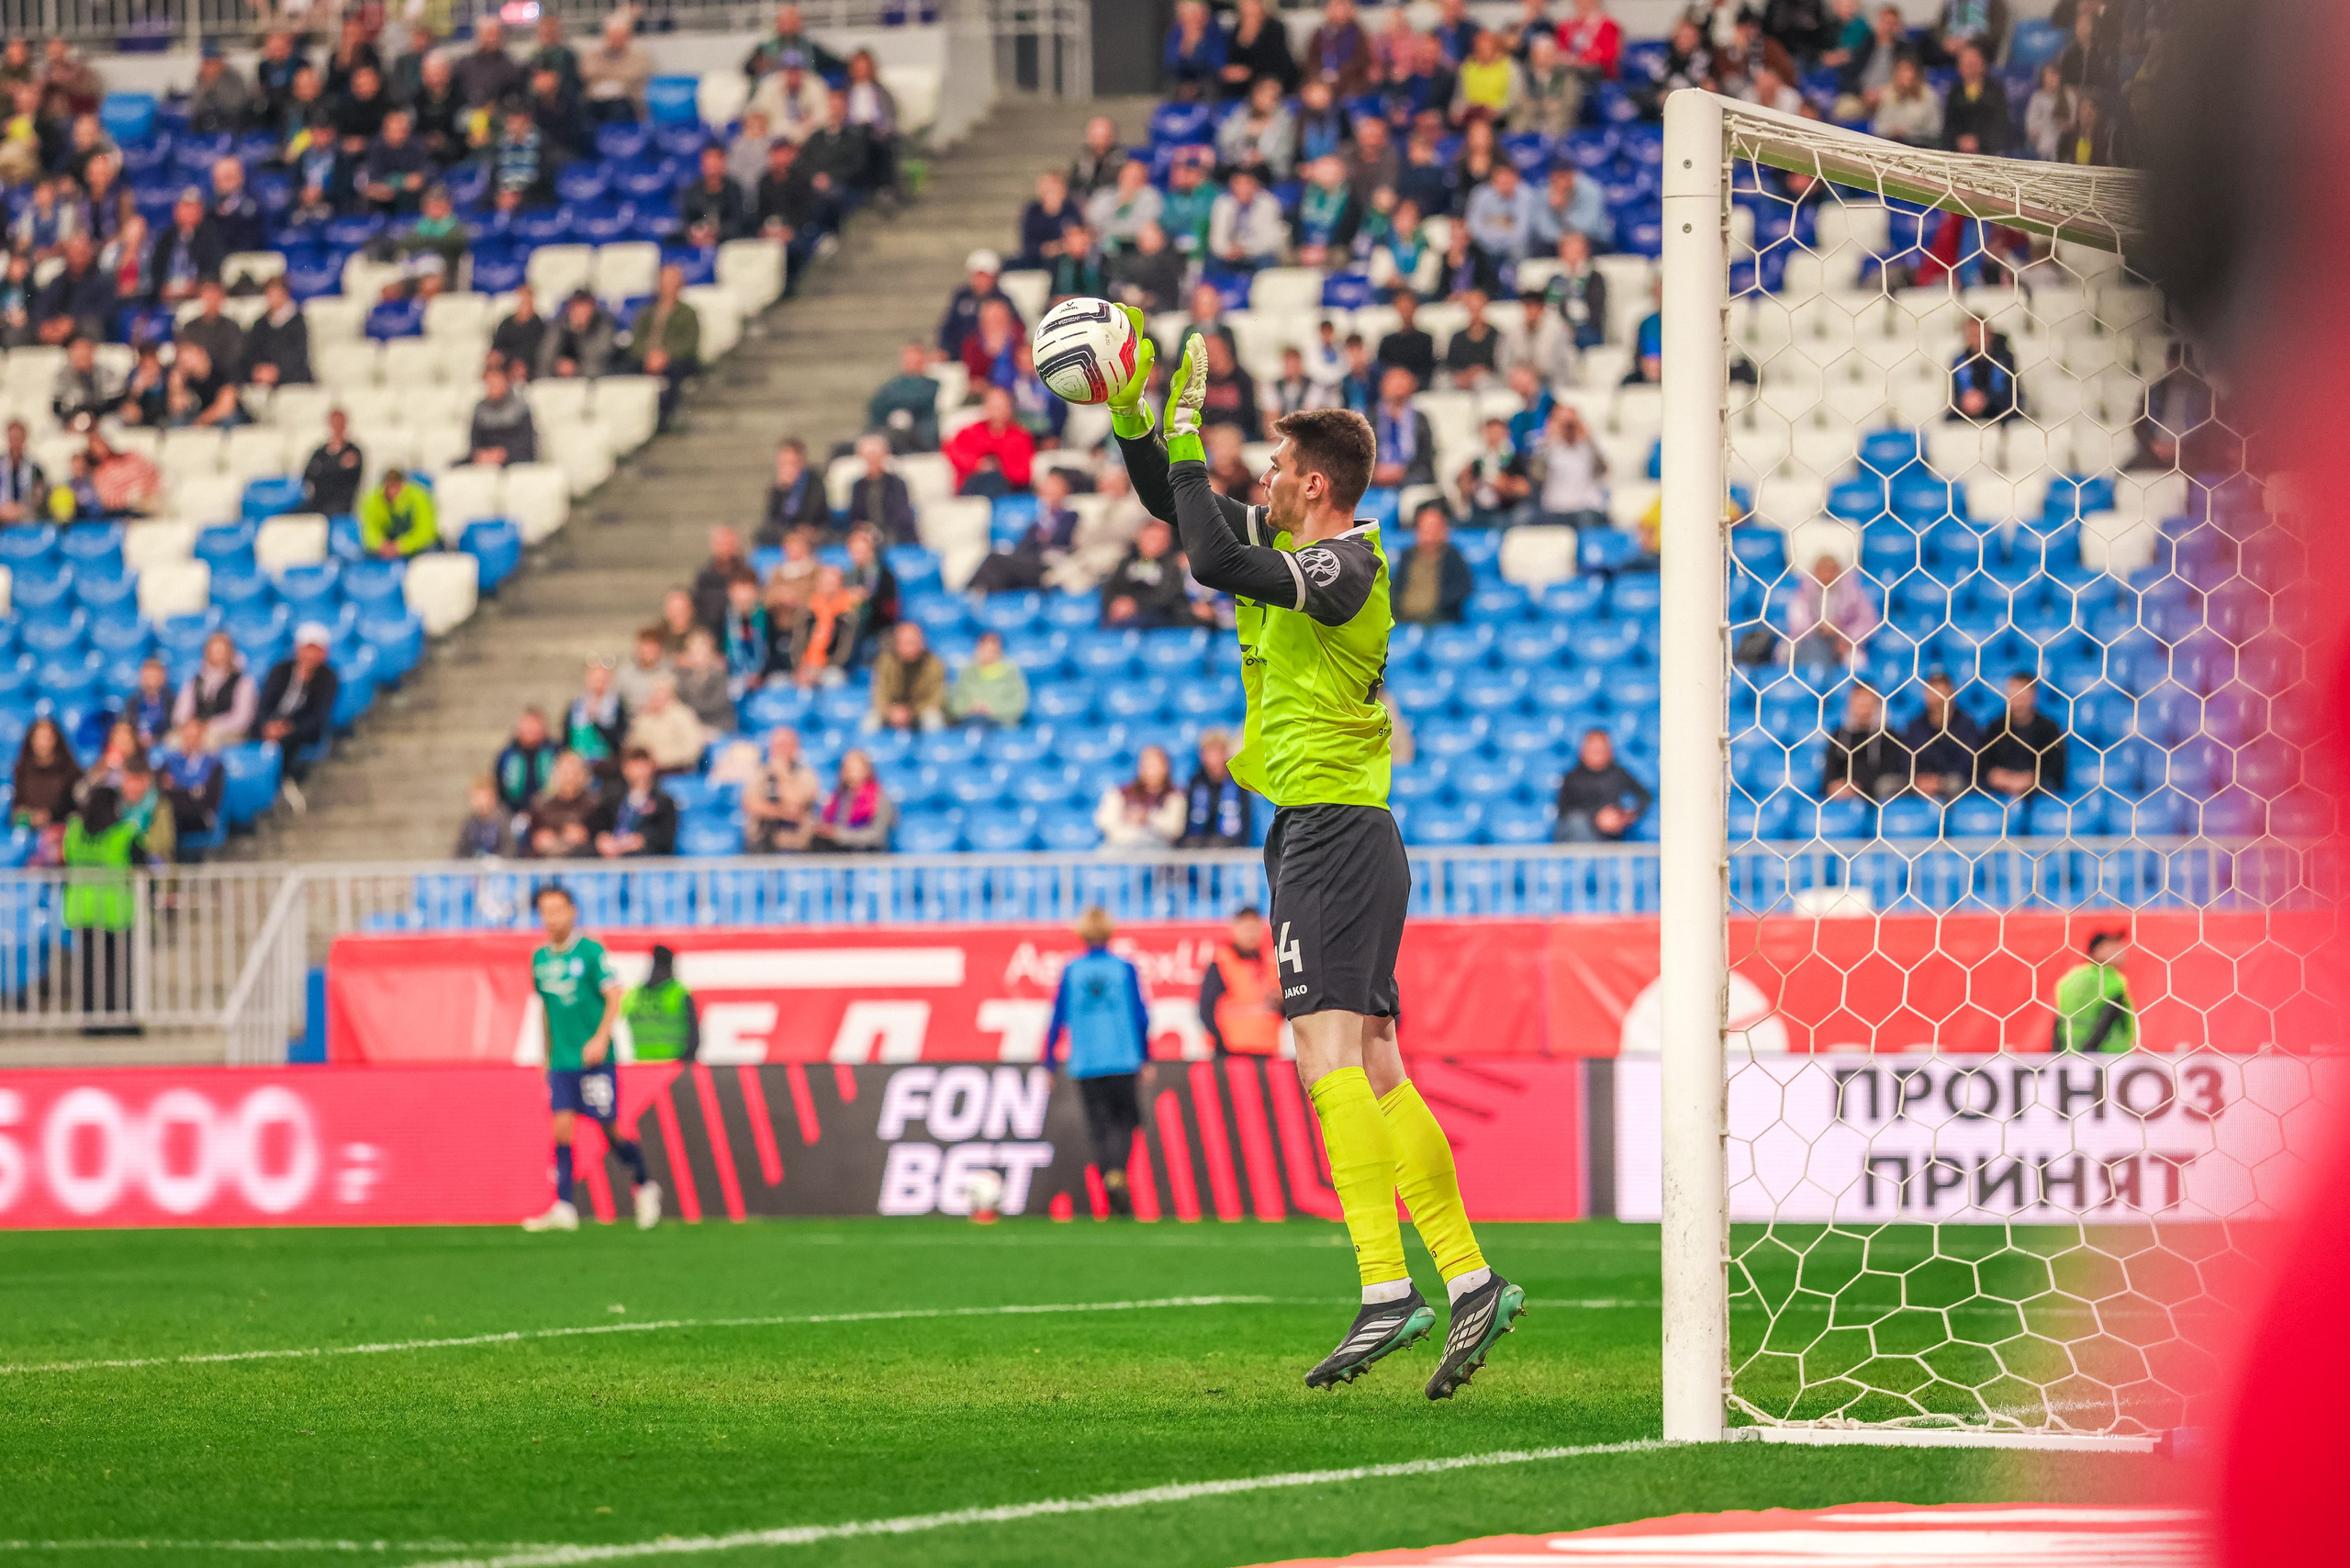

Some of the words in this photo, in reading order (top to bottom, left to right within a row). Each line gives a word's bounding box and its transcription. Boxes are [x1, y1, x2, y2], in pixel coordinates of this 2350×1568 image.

[1274, 921, 1304, 979] 4
[1284, 984, 1308, 1000] JAKO
[877, 1065, 1051, 1141] FON
[1836, 1067, 2226, 1122] ПРОГНОЗ
[877, 1141, 1056, 1216] BET
[1864, 1153, 2197, 1209] ПРИНЯТ
